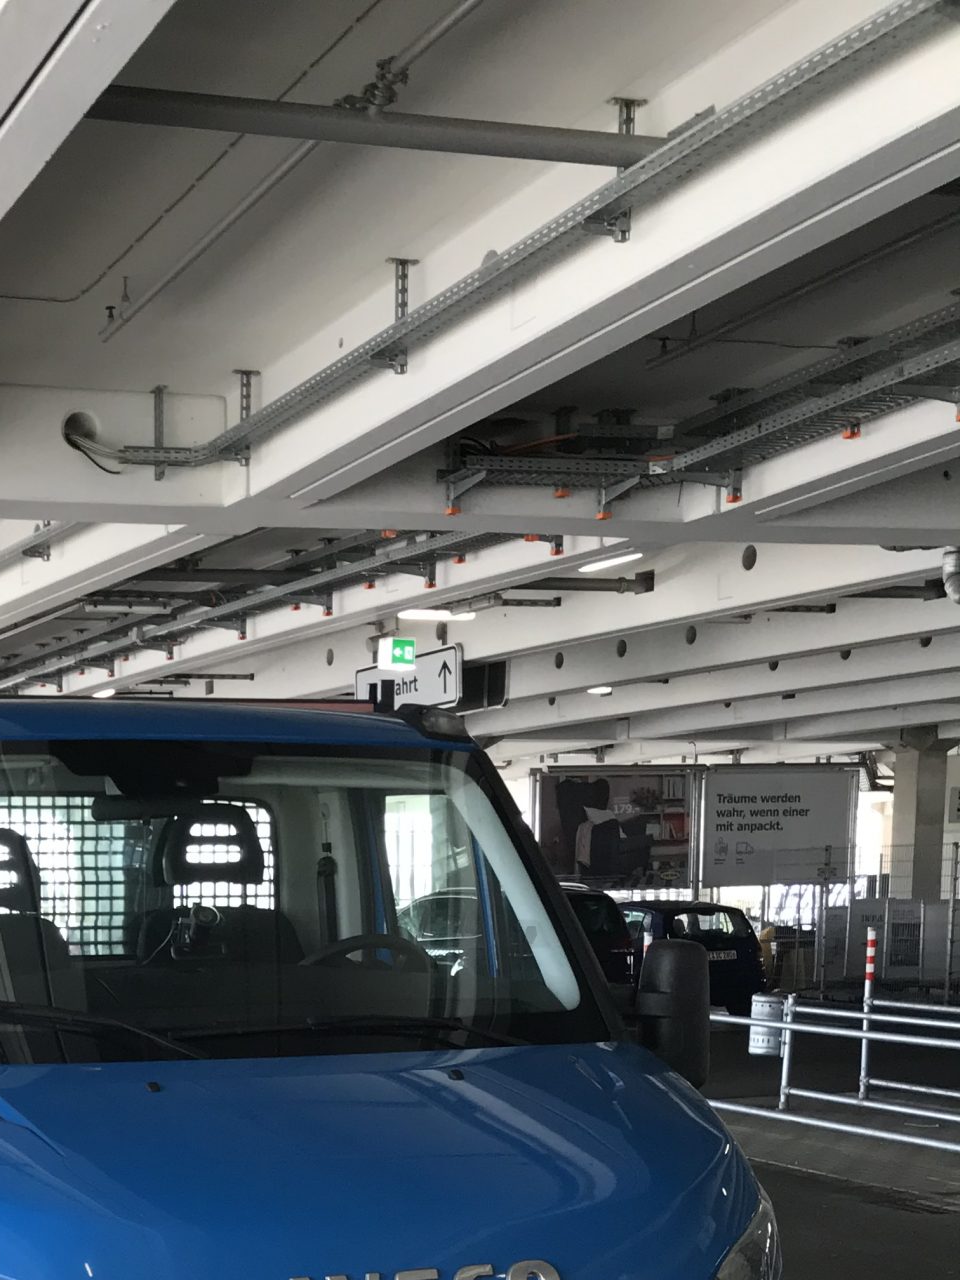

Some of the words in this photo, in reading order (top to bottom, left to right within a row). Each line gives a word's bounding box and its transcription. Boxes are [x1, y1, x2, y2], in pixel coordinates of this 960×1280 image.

[716, 793, 757, 804] Träume
[760, 793, 801, 803] werden
[716, 807, 746, 819] wahr,
[749, 808, 779, 817] wenn
[782, 807, 810, 817] einer
[716, 821, 734, 832] mit
[737, 821, 783, 833] anpackt.
